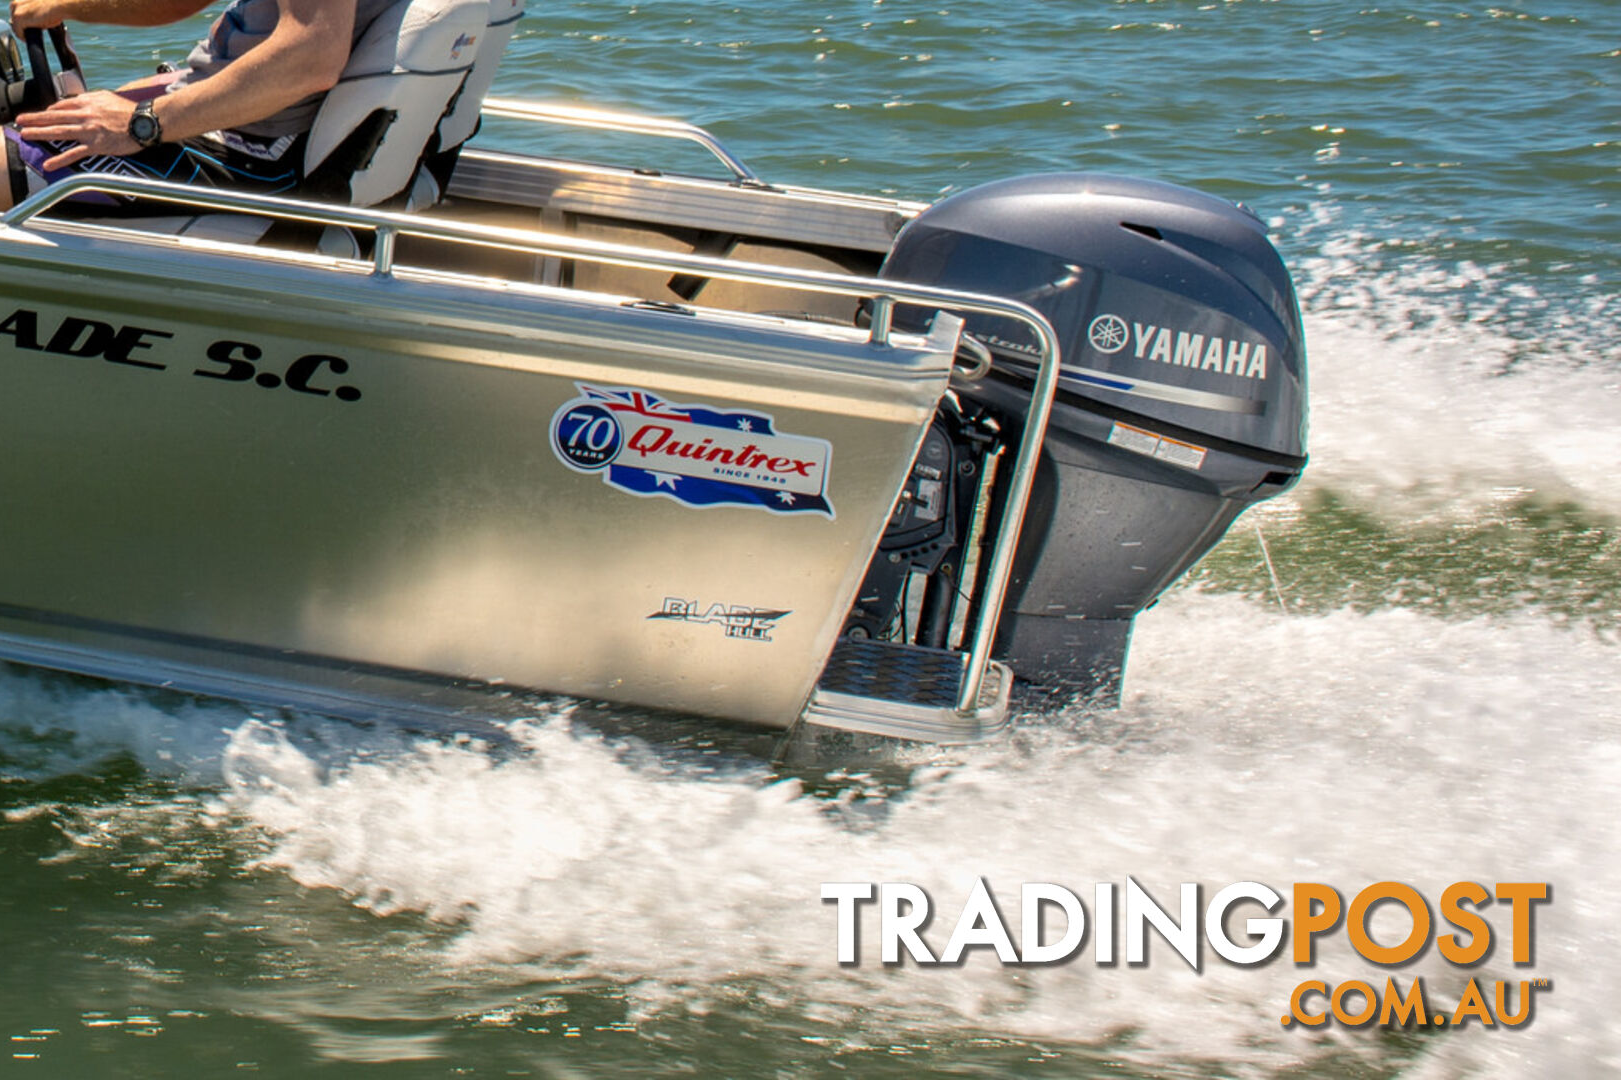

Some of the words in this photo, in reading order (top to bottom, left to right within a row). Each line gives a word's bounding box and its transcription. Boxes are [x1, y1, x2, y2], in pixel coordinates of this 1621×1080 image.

[193, 340, 362, 402] S.C.
[1134, 322, 1267, 380] YAMAHA
[568, 411, 616, 451] 70
[627, 424, 817, 477] Quintrex
[568, 447, 605, 460] YEARS
[713, 466, 750, 478] SINCE
[663, 597, 778, 630] BLADE
